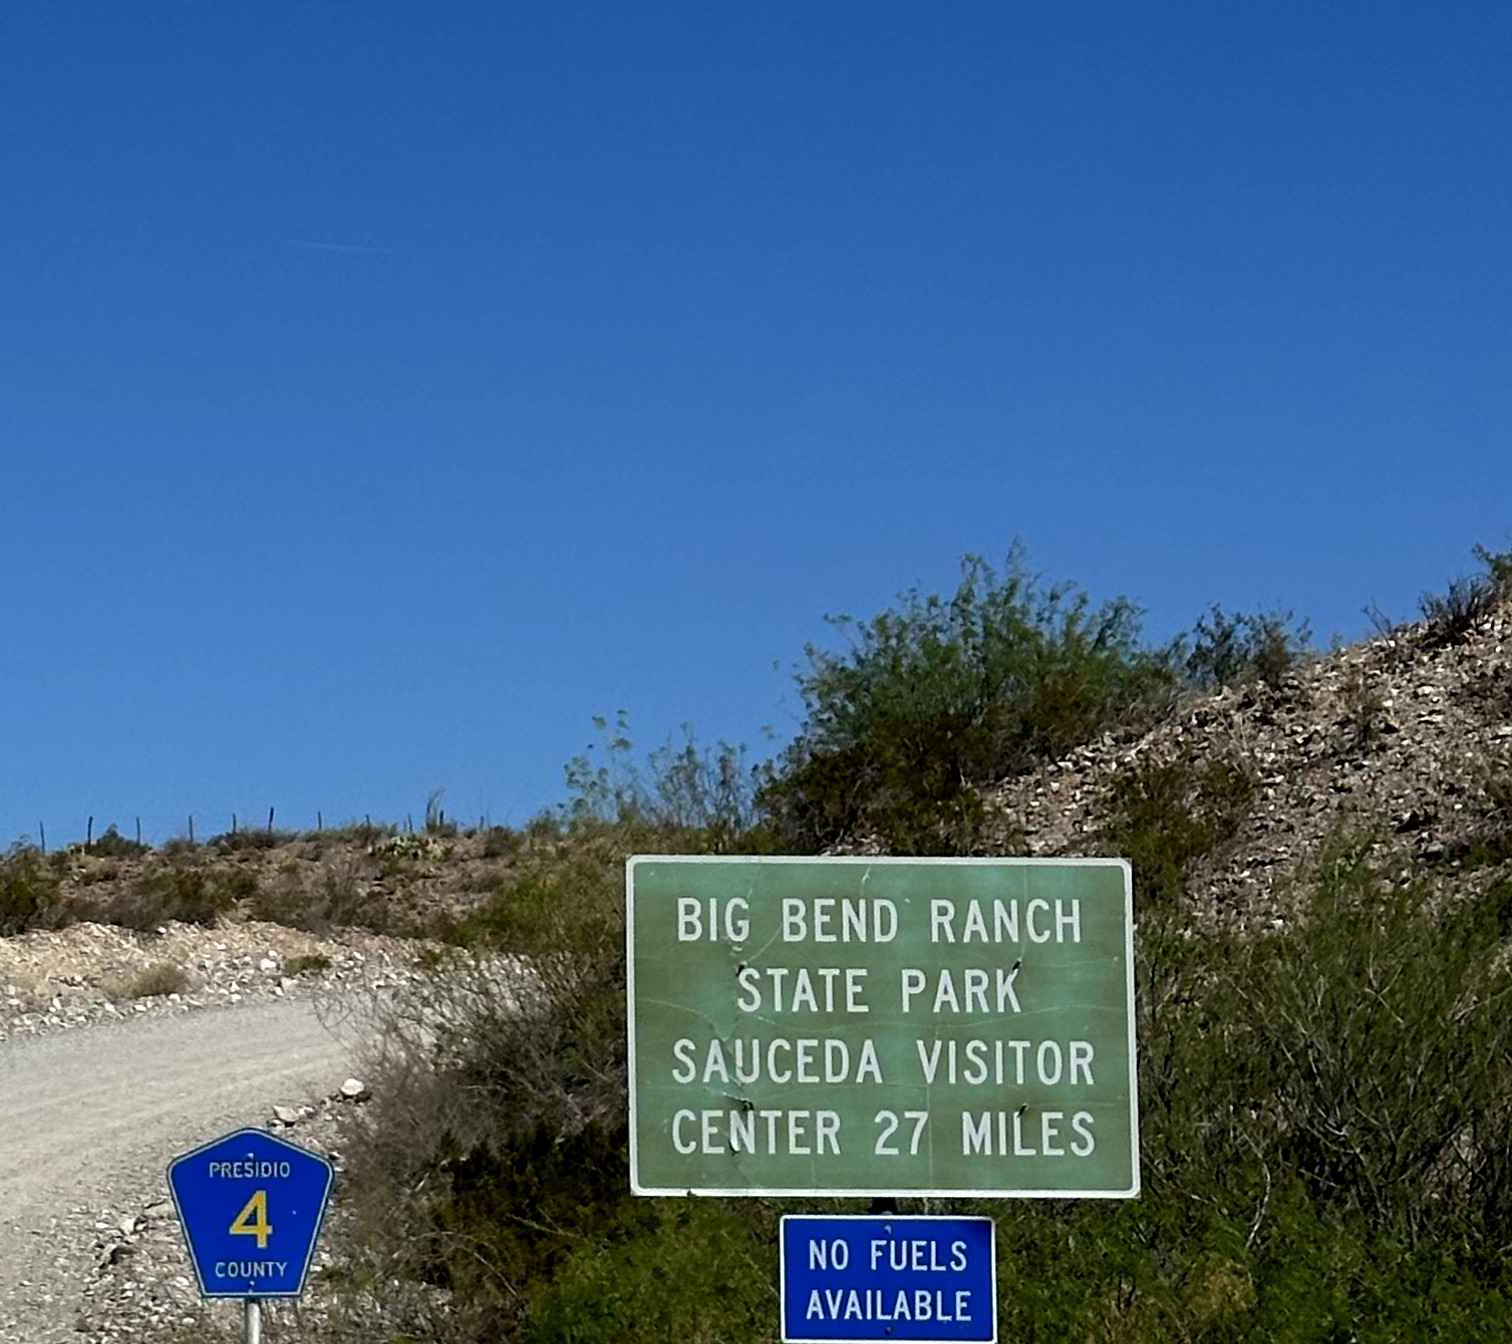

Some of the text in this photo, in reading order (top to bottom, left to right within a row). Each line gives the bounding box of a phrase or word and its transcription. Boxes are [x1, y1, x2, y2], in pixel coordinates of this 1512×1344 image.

[677, 897, 1082, 944] BIG BEND RANCH
[736, 968, 1022, 1013] STATE PARK
[672, 1038, 1095, 1086] SAUCEDA VISITOR
[672, 1110, 1096, 1157] CENTER 27 MILES
[209, 1161, 290, 1178] PRESIDIO
[229, 1189, 273, 1249] 4
[215, 1261, 288, 1277] COUNTY
[808, 1239, 968, 1272] NO FUELS
[806, 1289, 972, 1322] AVAILABLE
